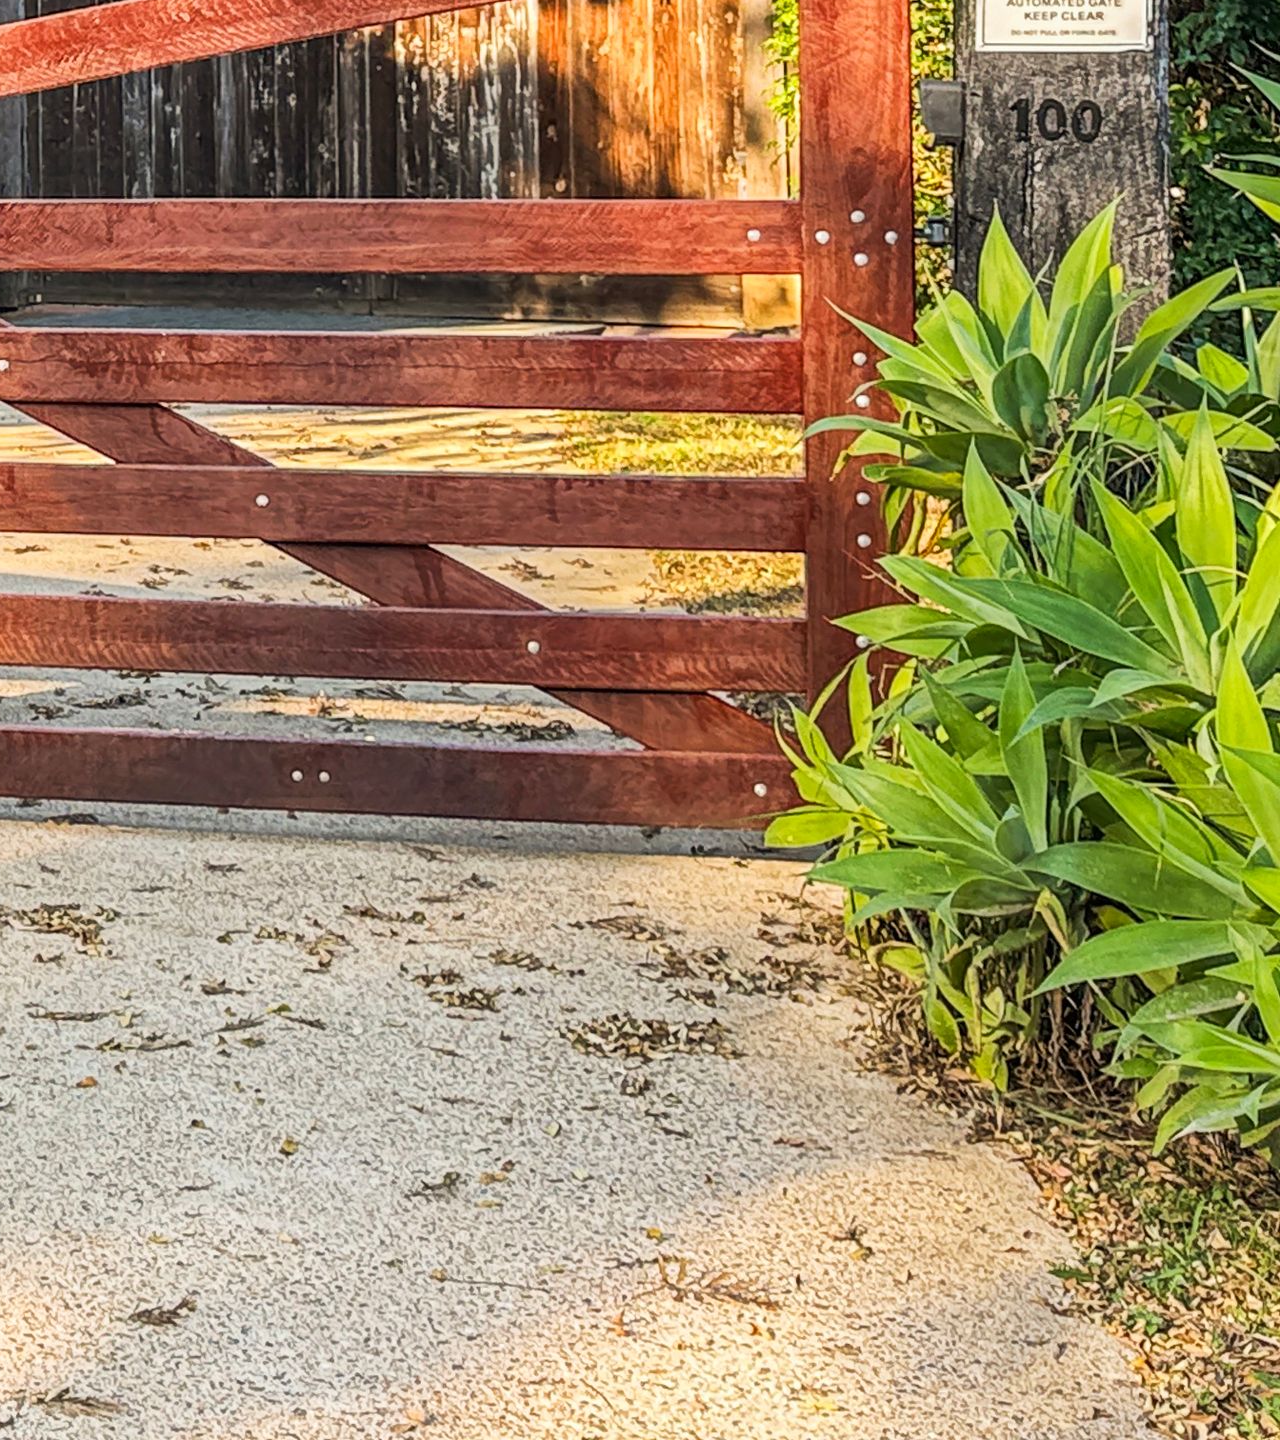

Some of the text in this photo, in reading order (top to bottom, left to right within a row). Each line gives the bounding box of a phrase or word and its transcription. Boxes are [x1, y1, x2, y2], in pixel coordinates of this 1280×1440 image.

[1023, 11, 1105, 21] KEEP CLEAR
[1010, 98, 1103, 143] 100
